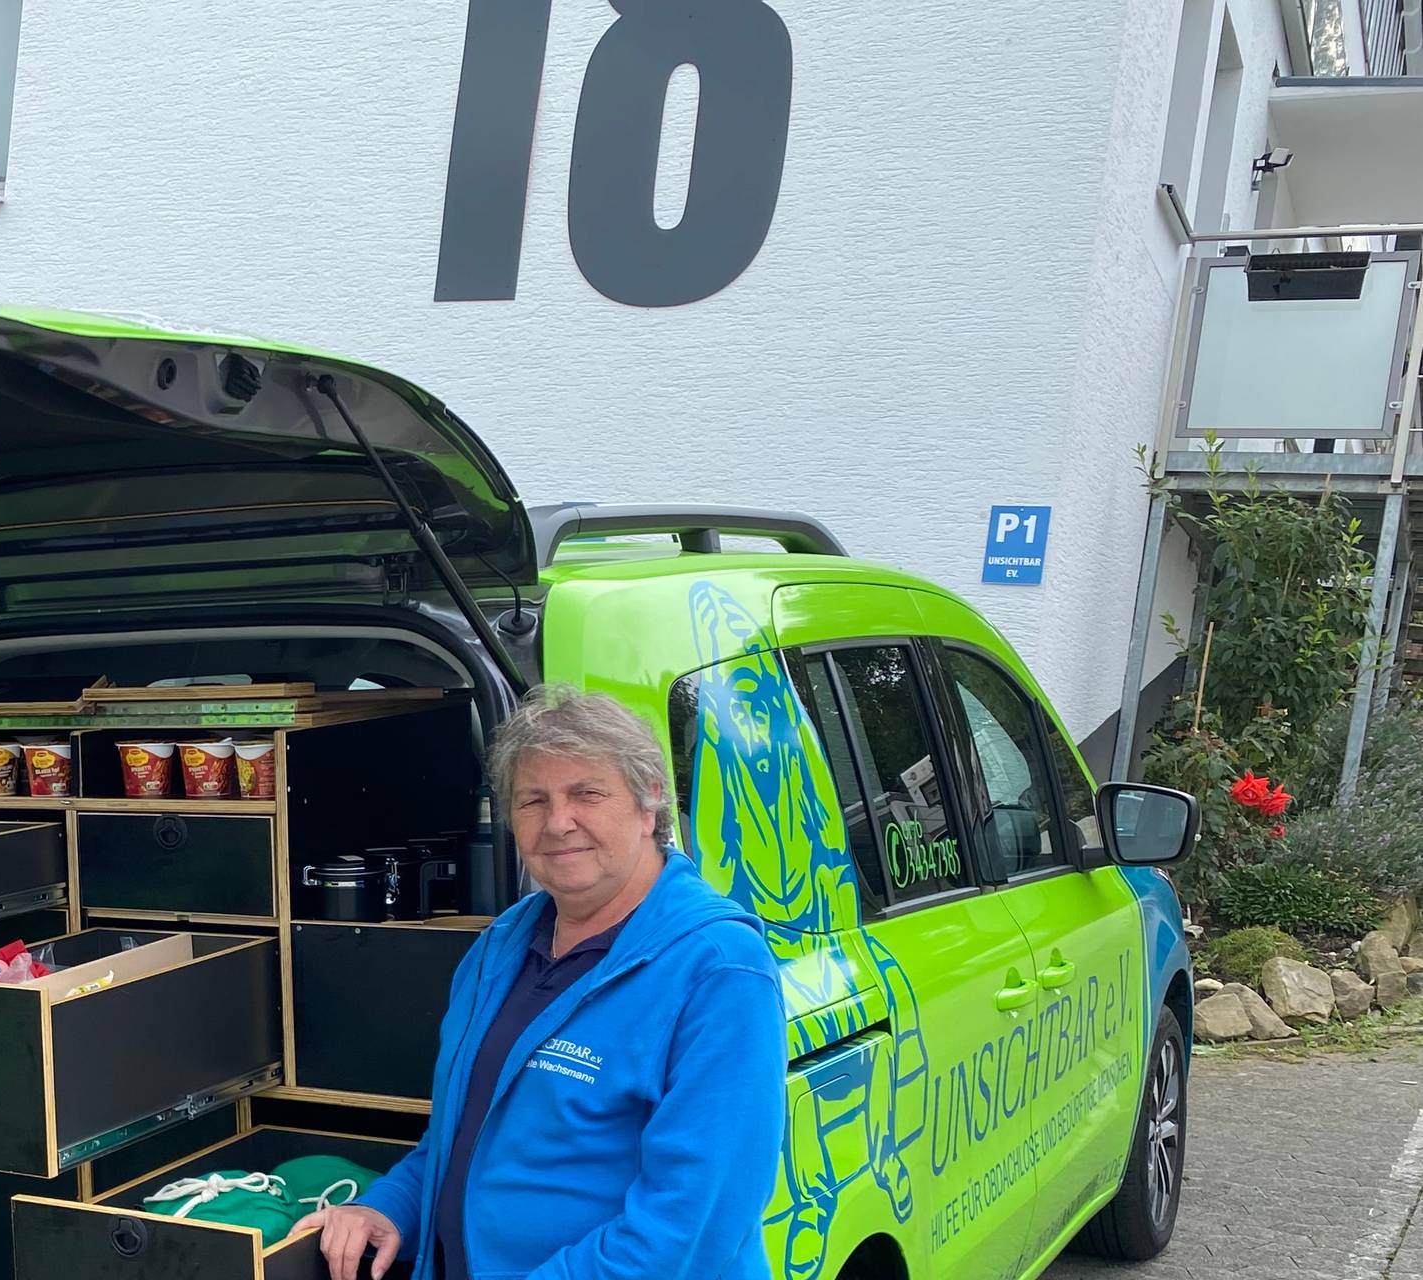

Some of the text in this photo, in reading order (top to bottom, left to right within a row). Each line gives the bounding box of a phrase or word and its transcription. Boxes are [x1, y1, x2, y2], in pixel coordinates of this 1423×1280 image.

[433, 0, 793, 308] 18
[996, 512, 1037, 544] P1
[988, 556, 1042, 567] UNSICHTBAR
[543, 1038, 591, 1060] CHTBAR
[931, 950, 1134, 1177] UNSICHTBAR e.V.
[539, 1059, 595, 1085] Wachsmann
[931, 1199, 961, 1253] HILFE
[961, 1177, 983, 1228] FÜR
[983, 1131, 1041, 1206] OBDACHLOSE
[1040, 1116, 1058, 1157] UND
